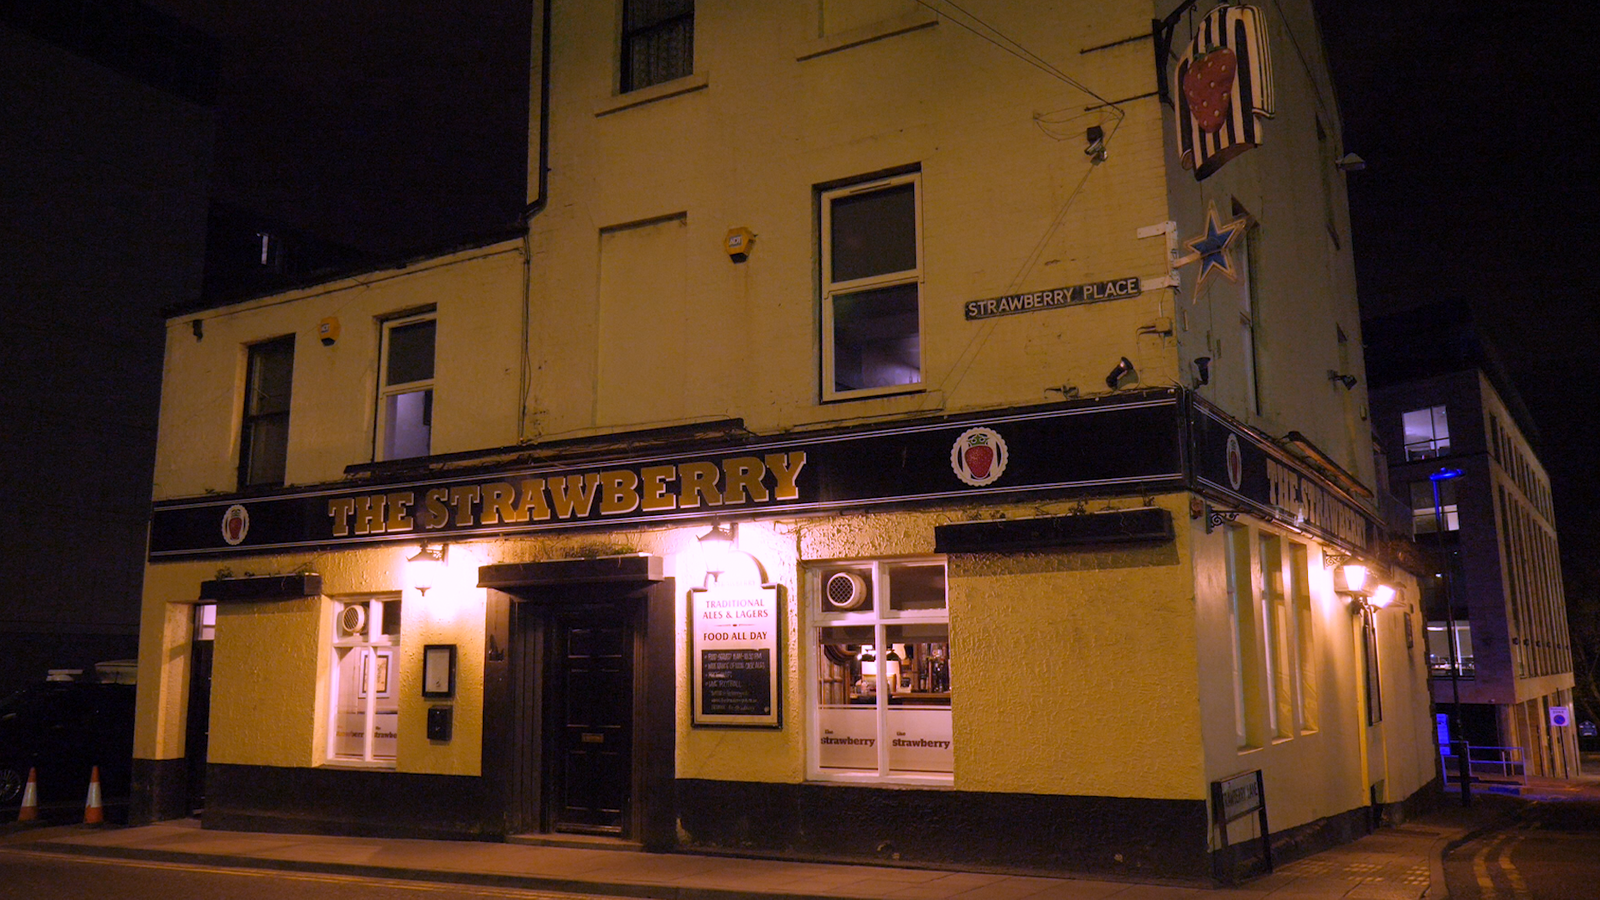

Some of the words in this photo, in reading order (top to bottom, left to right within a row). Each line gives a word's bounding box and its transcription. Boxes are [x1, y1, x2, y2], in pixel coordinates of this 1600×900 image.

[969, 288, 1074, 316] STRAWBERRY
[1083, 279, 1138, 300] PLACE
[328, 492, 415, 537] THE
[425, 452, 807, 529] STRAWBERRY
[1266, 458, 1298, 516] THE
[1301, 478, 1367, 550] STRAWBERRY
[706, 599, 764, 609] TRADITIONAL
[703, 611, 723, 620] ALES
[726, 611, 732, 619] &
[735, 609, 769, 619] LAGERS
[703, 632, 729, 641] FOOD
[731, 631, 747, 641] ALL
[750, 631, 768, 640] DAY
[820, 736, 876, 748] strawberry
[892, 738, 951, 750] strawberry
